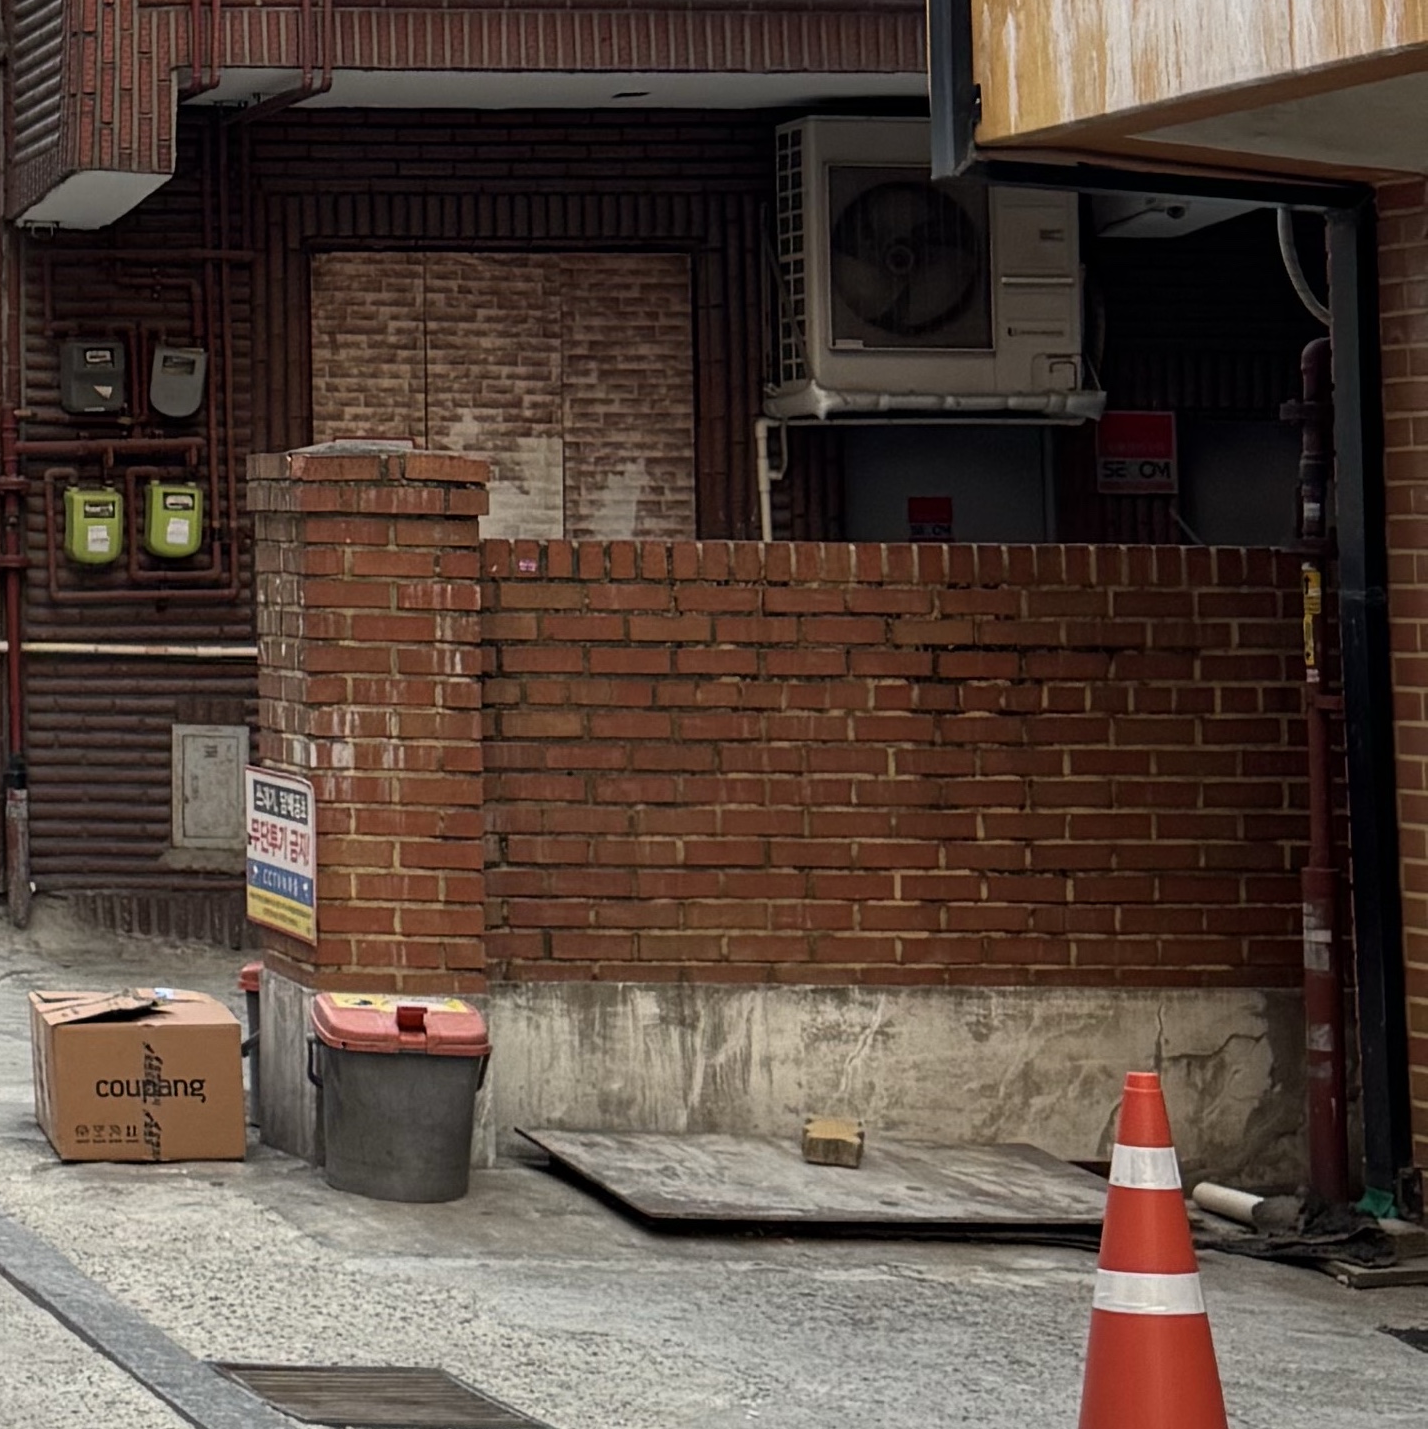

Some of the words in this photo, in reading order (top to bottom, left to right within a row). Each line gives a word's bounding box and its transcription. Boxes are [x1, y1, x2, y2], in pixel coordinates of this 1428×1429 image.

[1103, 461, 1171, 478] SEOM
[250, 818, 288, 861] 무단투기
[96, 1079, 206, 1103] coupang
